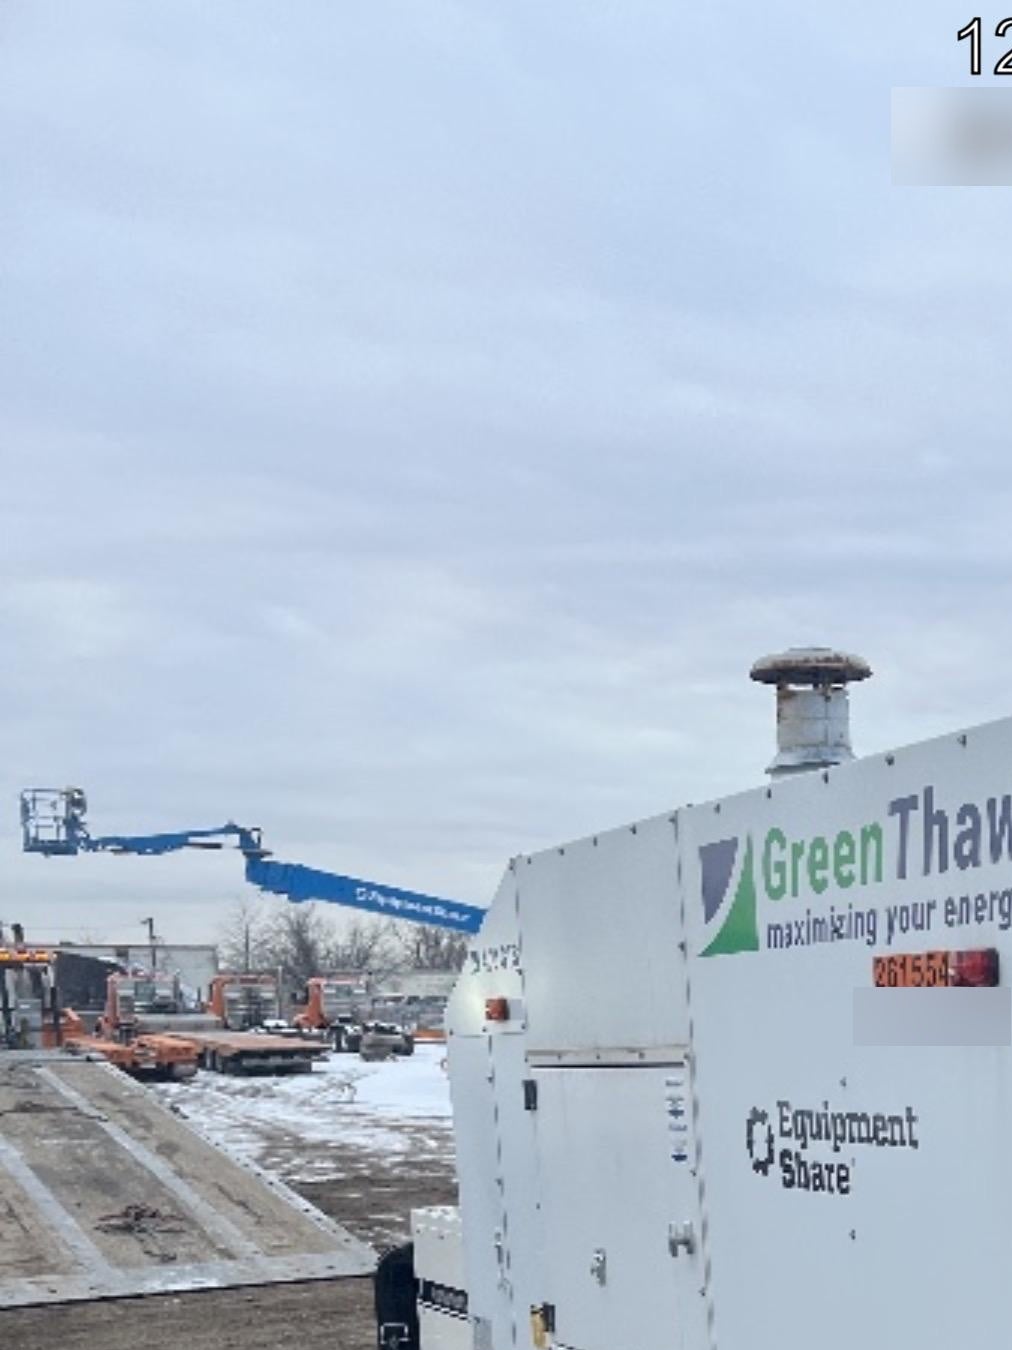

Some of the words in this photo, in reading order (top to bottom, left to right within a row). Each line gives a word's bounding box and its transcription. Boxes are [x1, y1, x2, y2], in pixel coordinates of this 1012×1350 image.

[766, 903, 877, 946] maximizing
[886, 896, 937, 945] your
[873, 950, 949, 988] 261554
[776, 1099, 919, 1152] Equipment
[779, 1149, 850, 1195] Share
